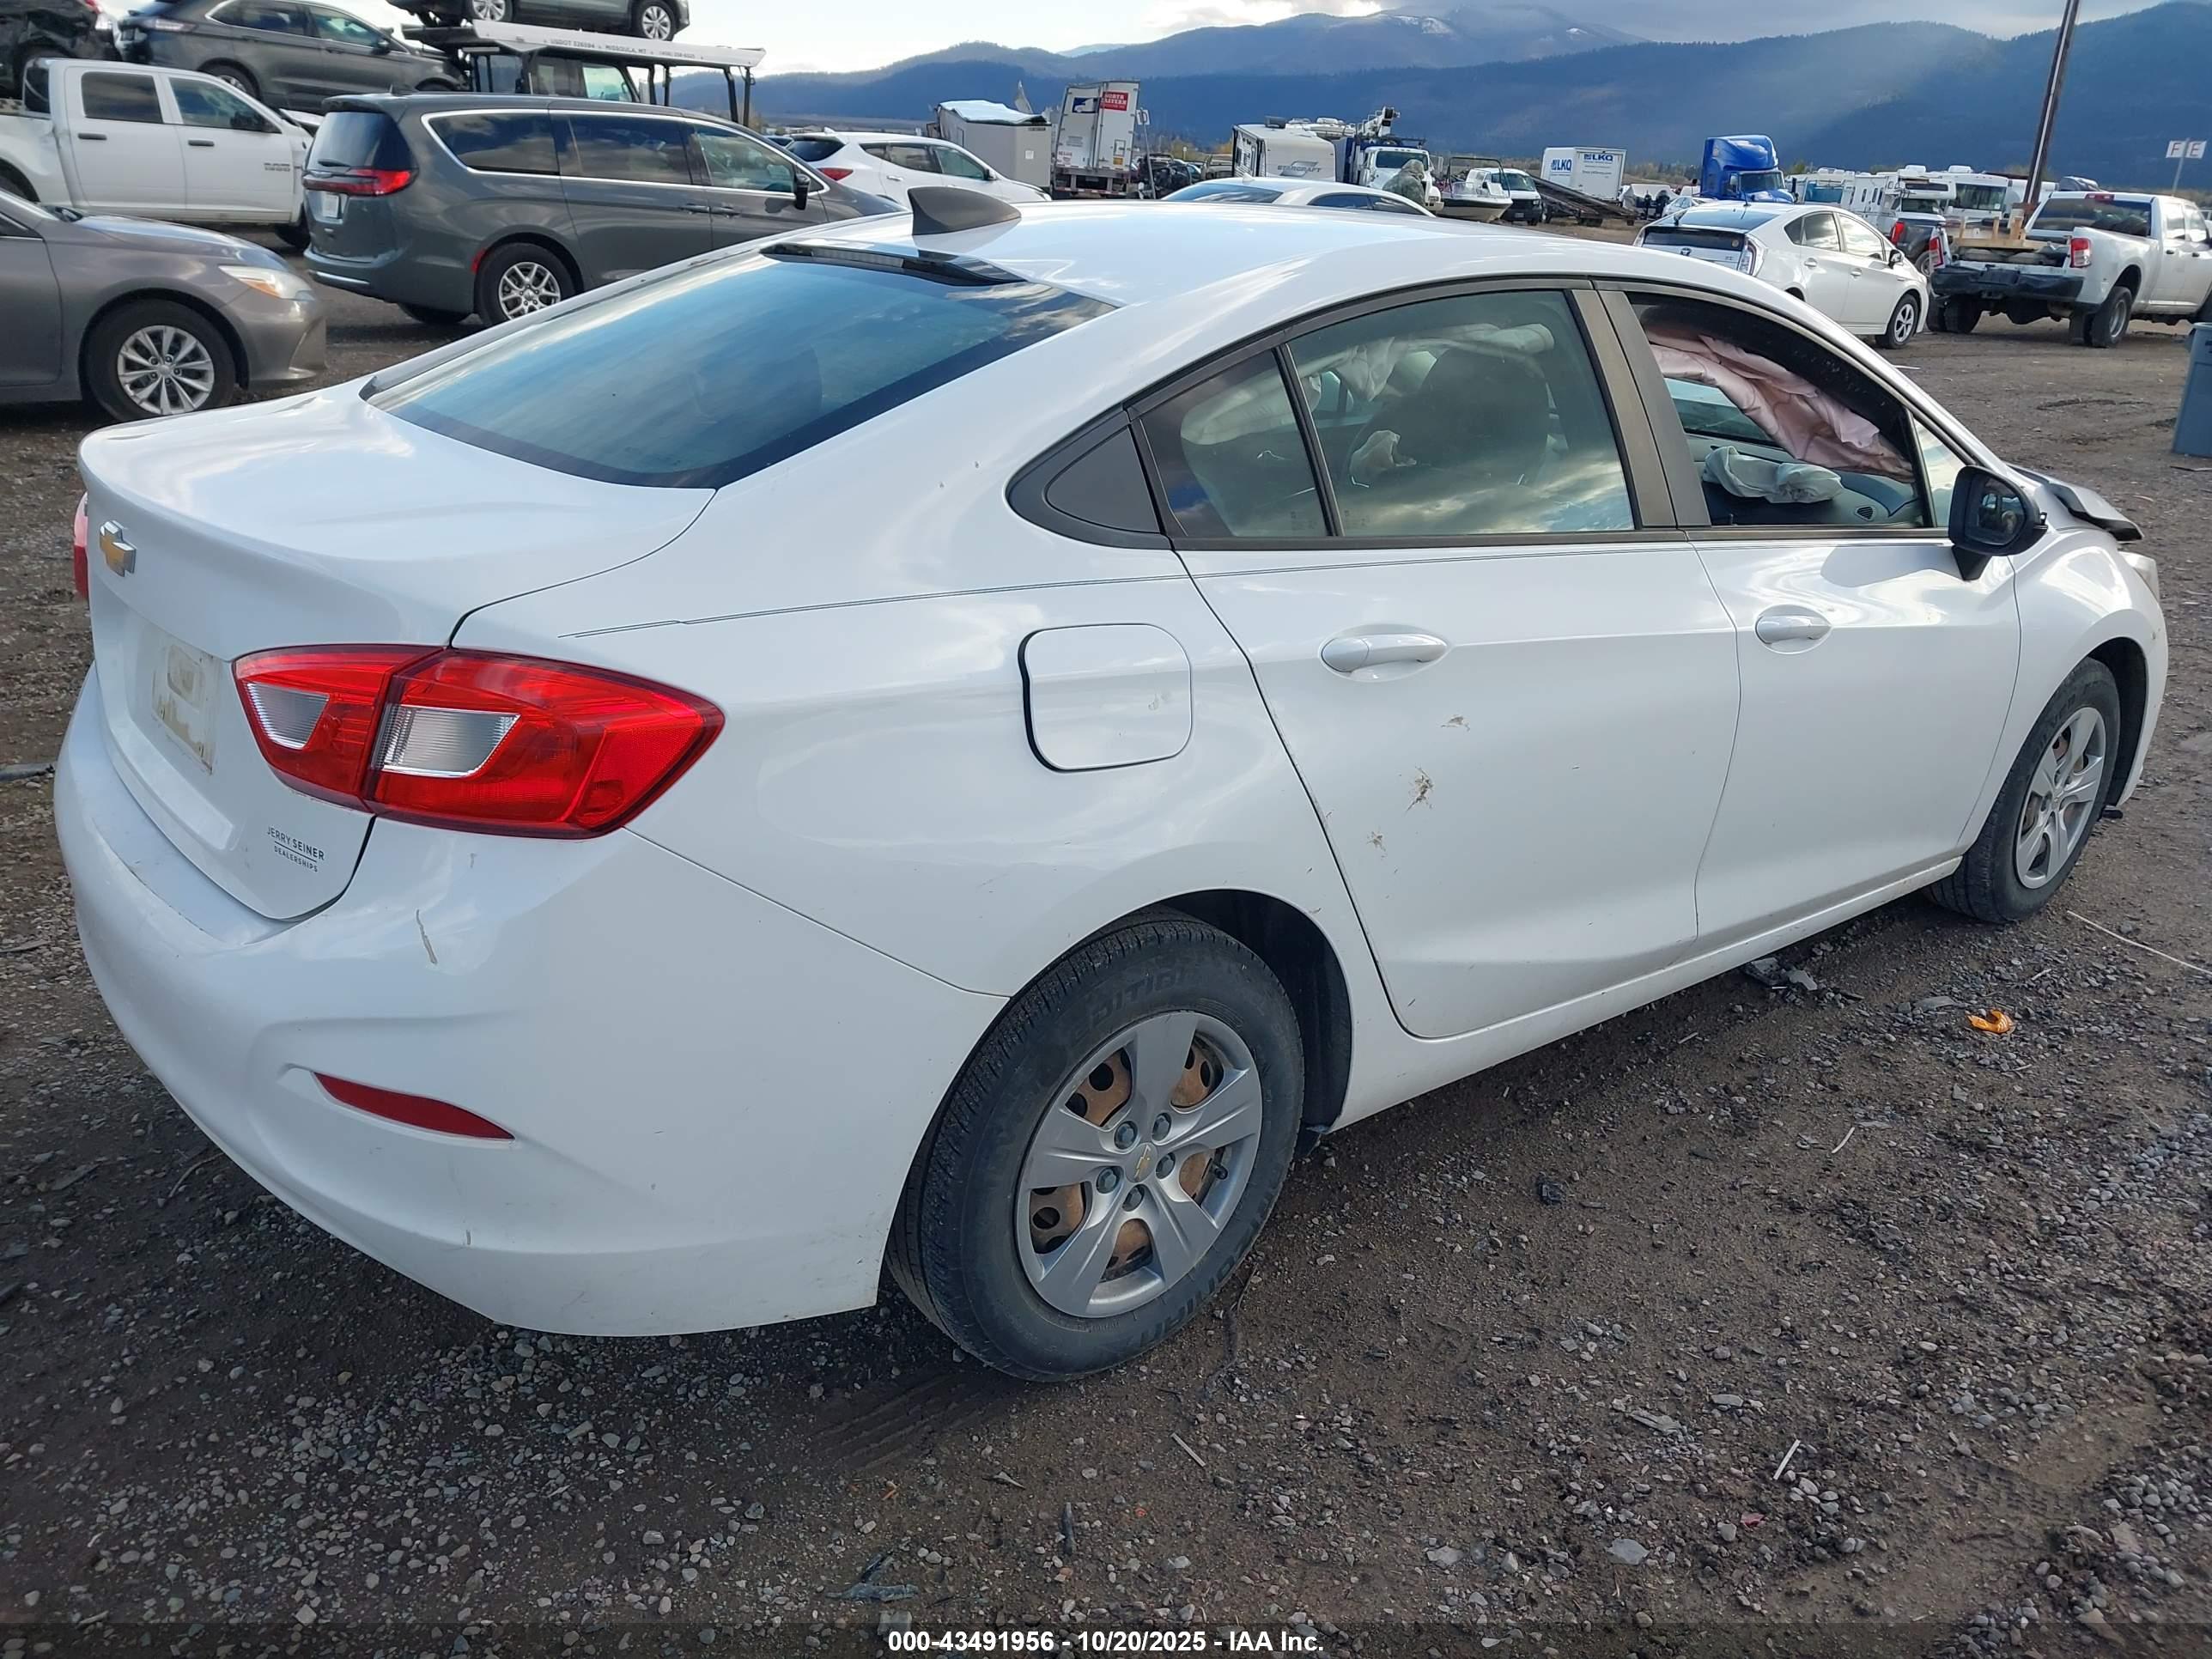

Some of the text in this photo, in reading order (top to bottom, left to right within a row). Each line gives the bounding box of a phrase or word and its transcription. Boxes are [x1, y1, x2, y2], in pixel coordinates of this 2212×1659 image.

[2170, 143, 2182, 156] F
[2190, 143, 2202, 156] E
[1557, 159, 1572, 172] LKQ
[267, 826, 325, 860] JERRY SEINER
[274, 845, 318, 872] DEALERSHIPS
